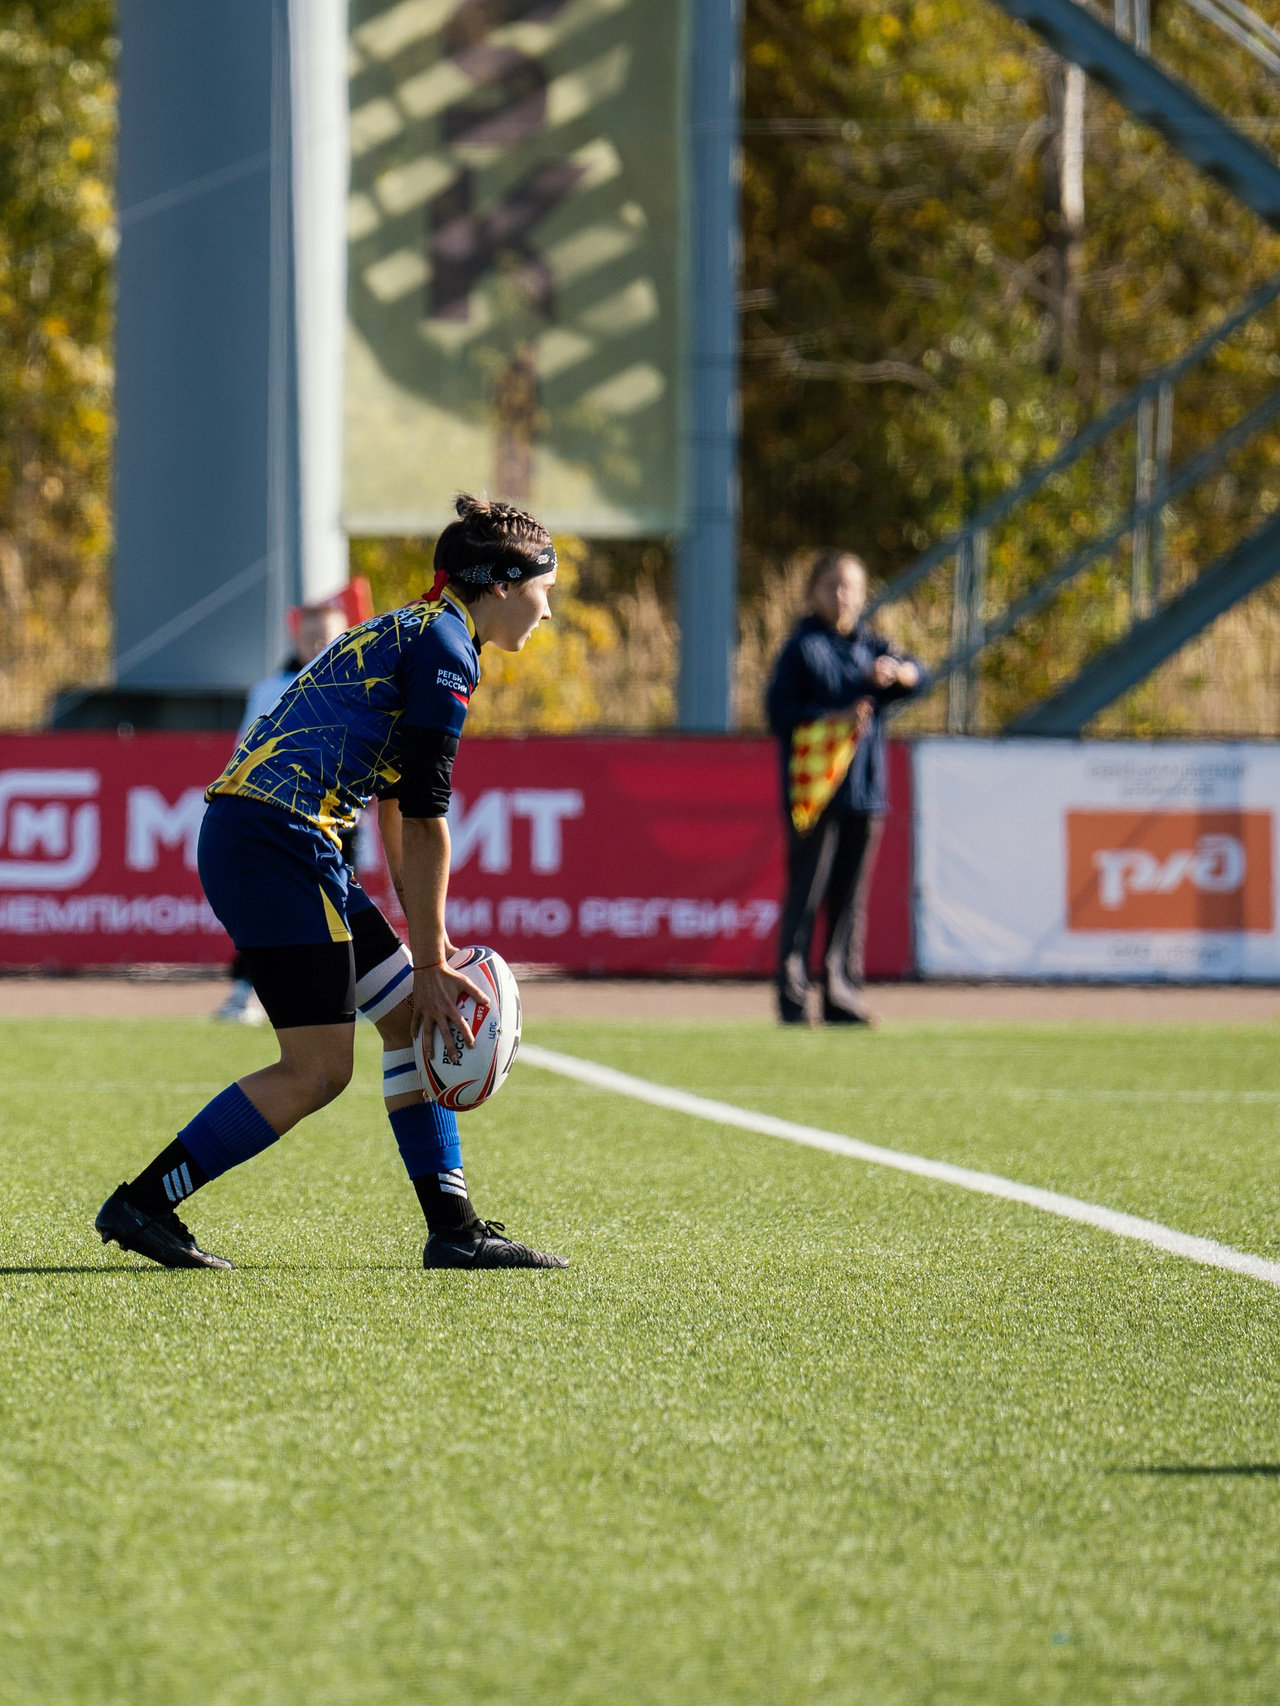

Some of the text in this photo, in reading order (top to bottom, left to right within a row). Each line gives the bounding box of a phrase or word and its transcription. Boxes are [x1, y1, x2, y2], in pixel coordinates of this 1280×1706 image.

[437, 669, 463, 683] РЕГБИ
[436, 677, 468, 694] РОССИИ
[126, 786, 583, 874] МИТ
[498, 898, 571, 936] ПО
[476, 1005, 485, 1020] 1892
[488, 1021, 497, 1040] ЦПС
